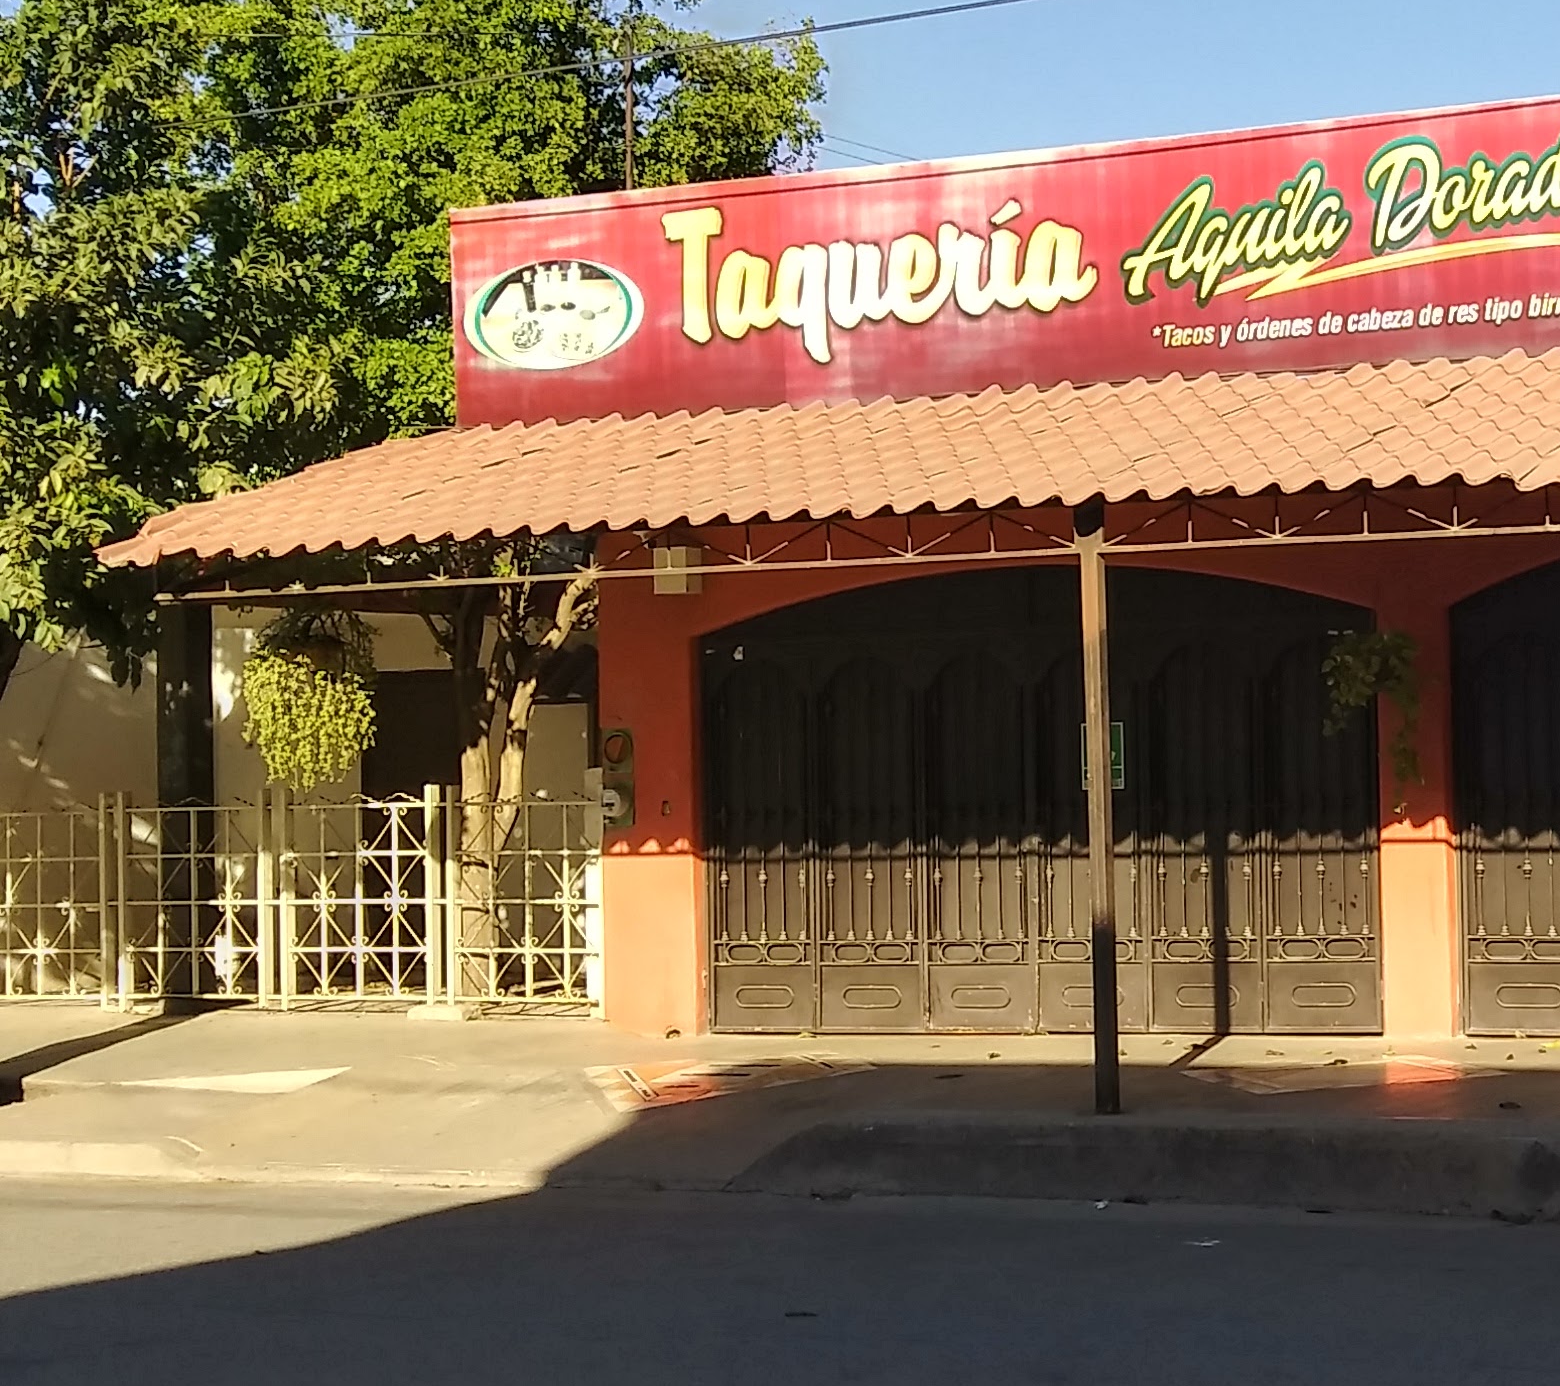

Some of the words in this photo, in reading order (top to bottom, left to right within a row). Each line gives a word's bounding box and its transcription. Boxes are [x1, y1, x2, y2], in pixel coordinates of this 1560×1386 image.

[661, 199, 1098, 364] Taquería
[1218, 323, 1233, 349] y
[1236, 317, 1313, 342] órdenes
[1318, 311, 1344, 335] de
[1346, 307, 1414, 332] cabeza
[1417, 303, 1444, 327] de
[1447, 303, 1481, 325] res
[1484, 296, 1524, 326] tipo
